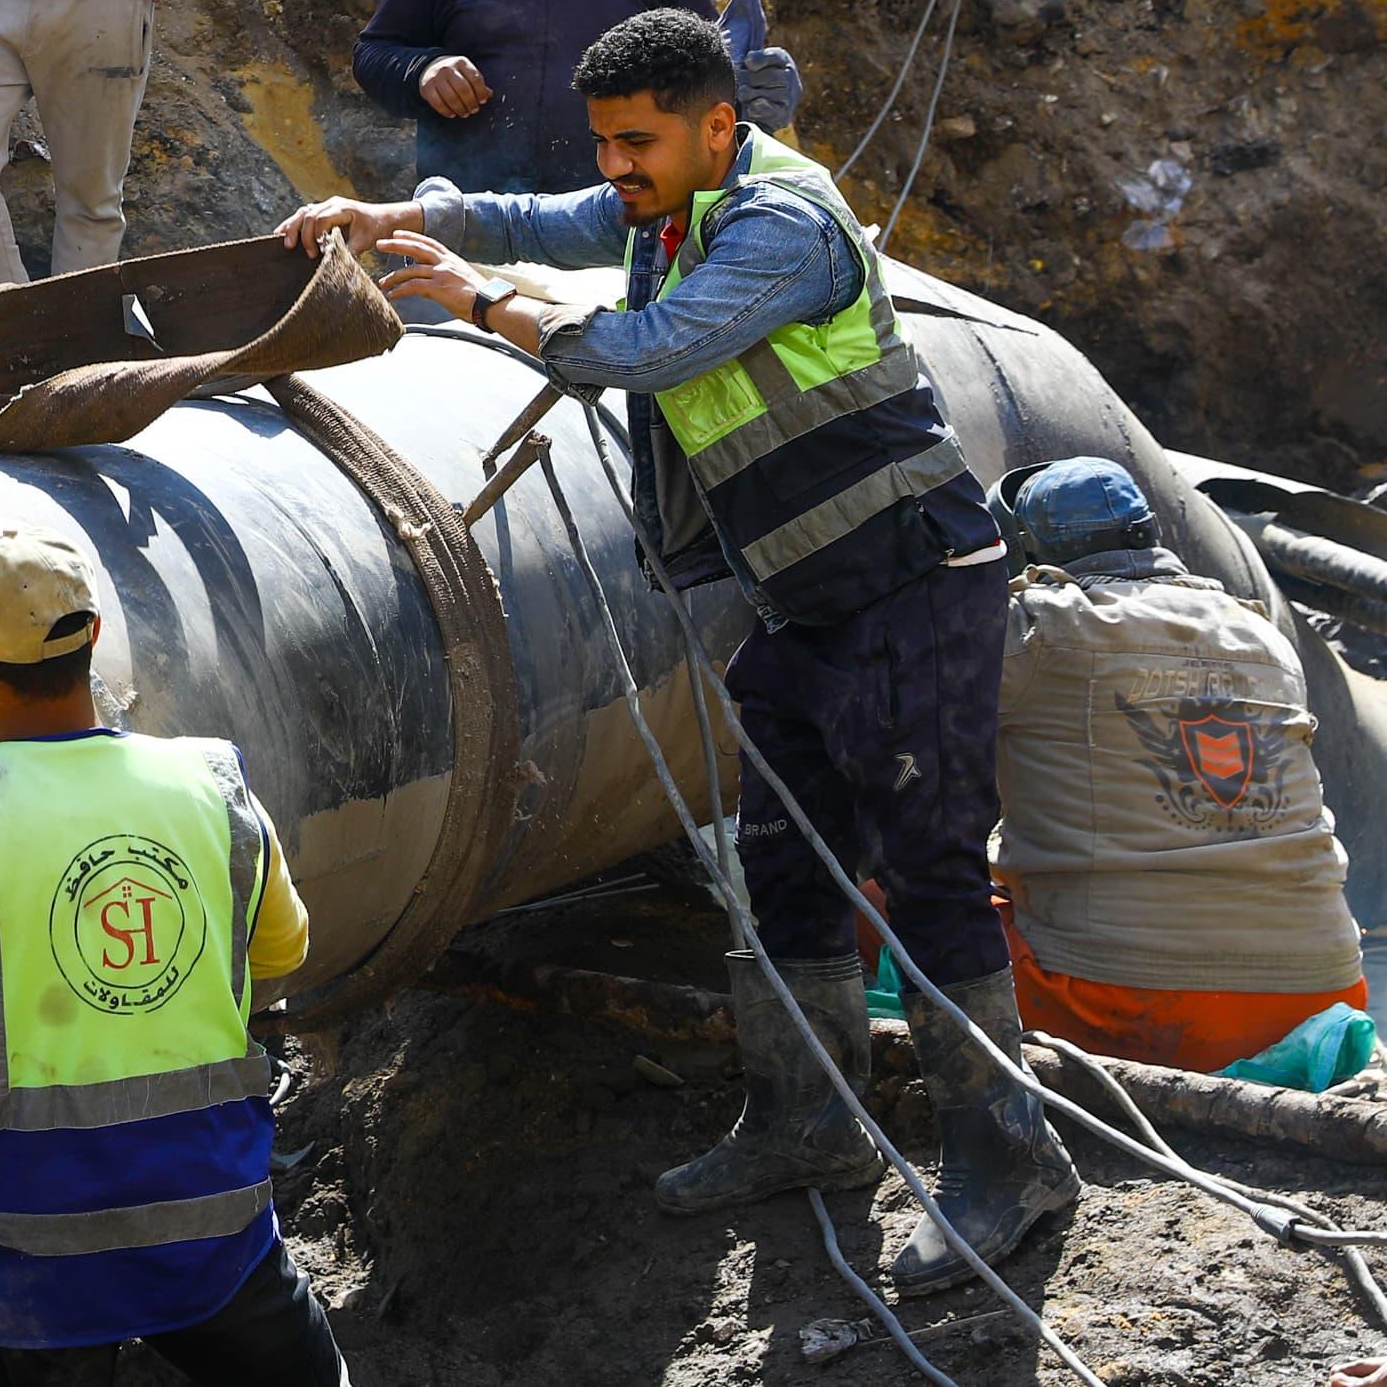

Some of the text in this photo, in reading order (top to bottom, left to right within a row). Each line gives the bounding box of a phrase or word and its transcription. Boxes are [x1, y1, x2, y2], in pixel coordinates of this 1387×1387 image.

[745, 819, 787, 836] BRAND
[65, 846, 189, 902] مكتب حافظ
[83, 966, 180, 1010] للمقاولات
